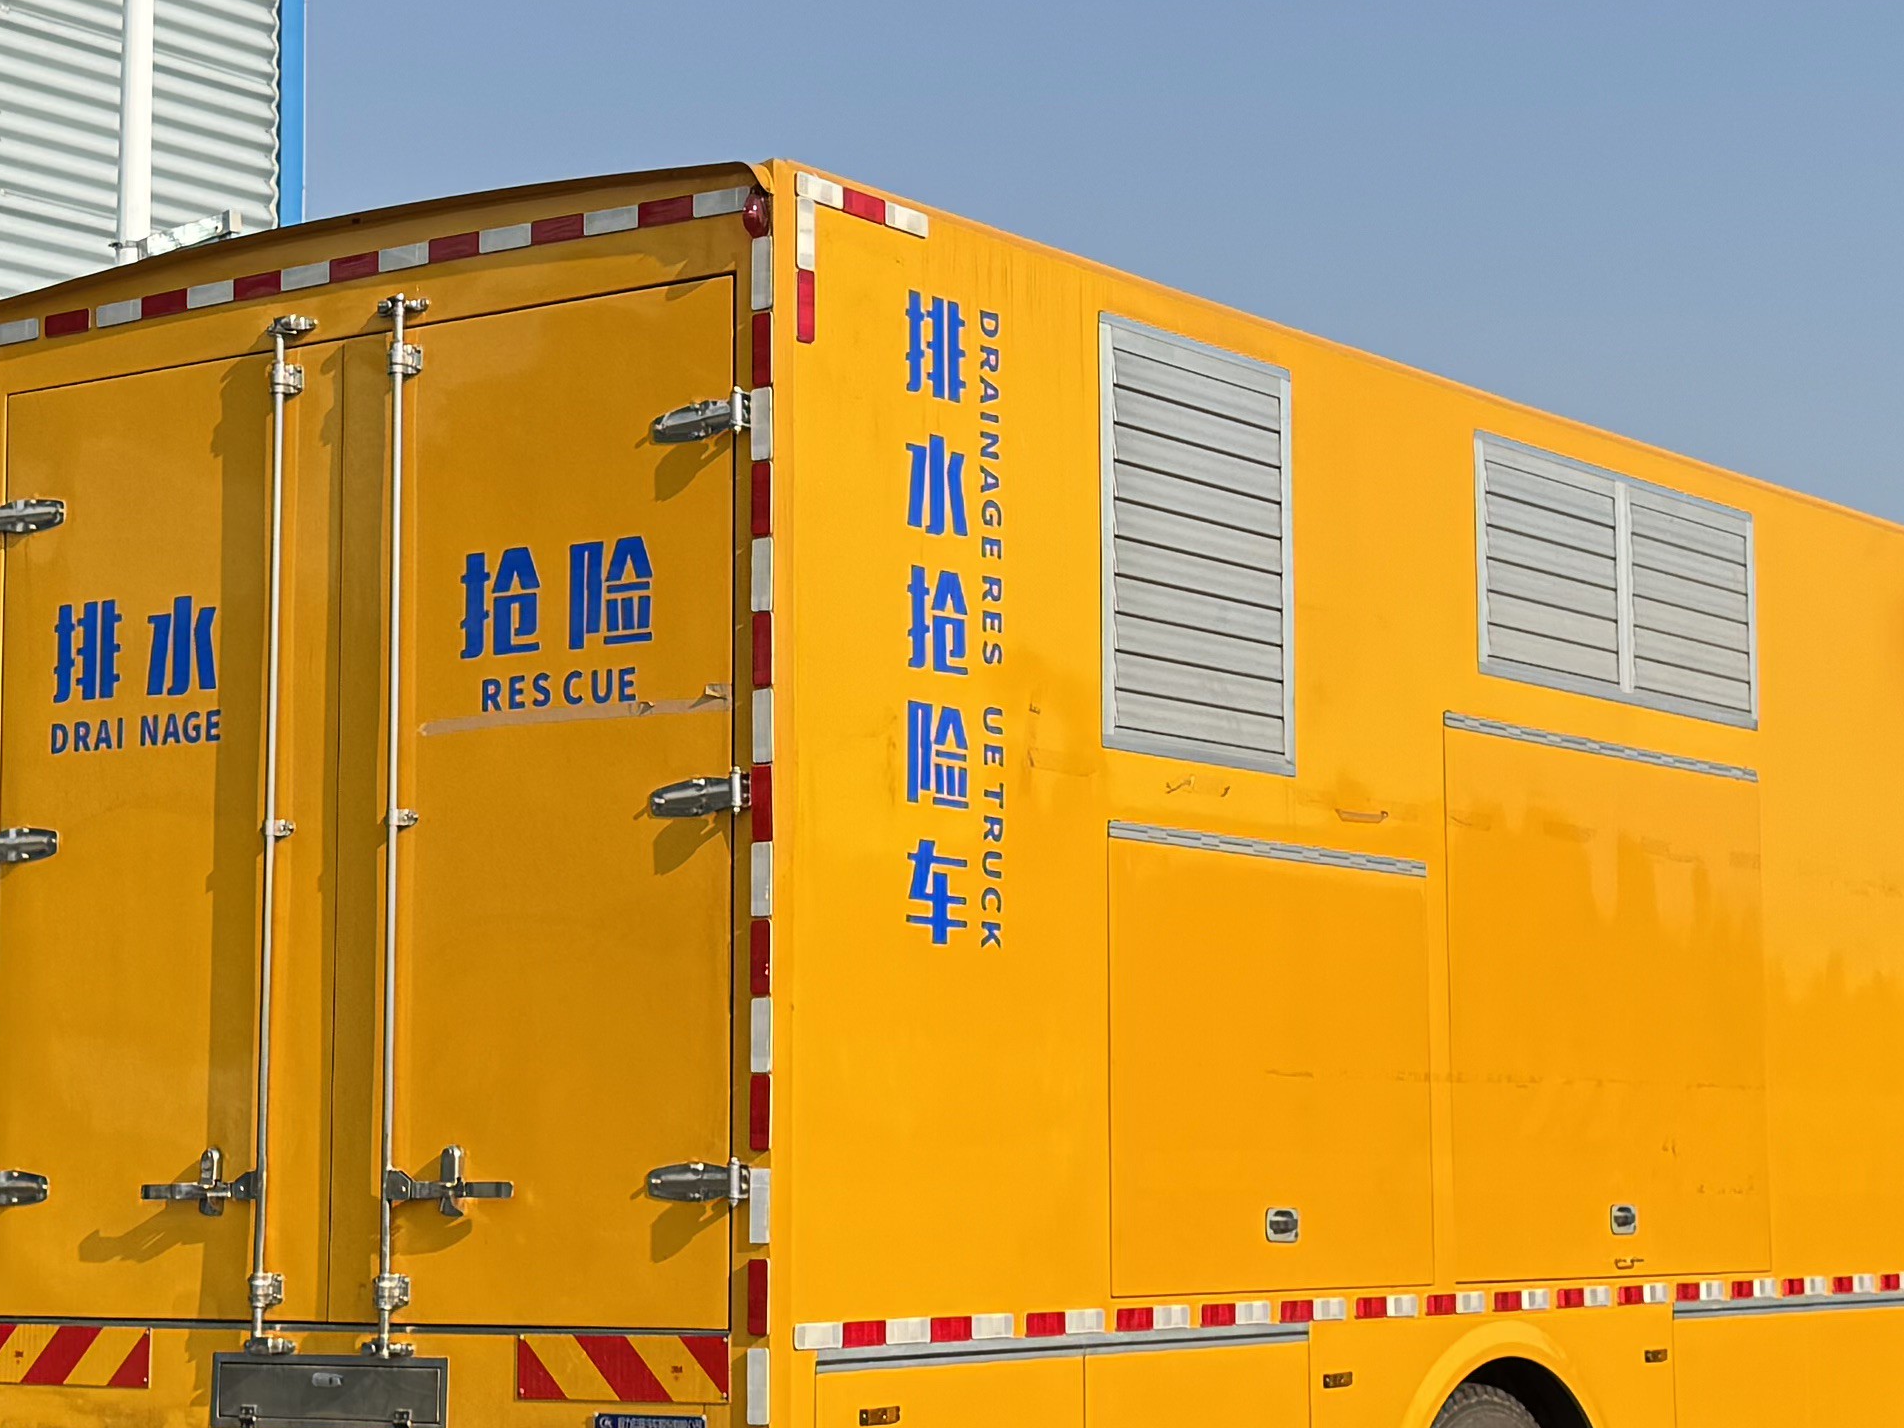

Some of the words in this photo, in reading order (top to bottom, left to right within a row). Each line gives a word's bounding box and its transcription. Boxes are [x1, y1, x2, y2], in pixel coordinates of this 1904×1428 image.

[979, 308, 1003, 560] DRAINAGE
[53, 595, 217, 704] 排水
[460, 536, 653, 660] 抢险
[906, 289, 968, 945] 排水抢险车
[481, 666, 637, 713] RESCUE
[980, 782, 1004, 949] TRUCK
